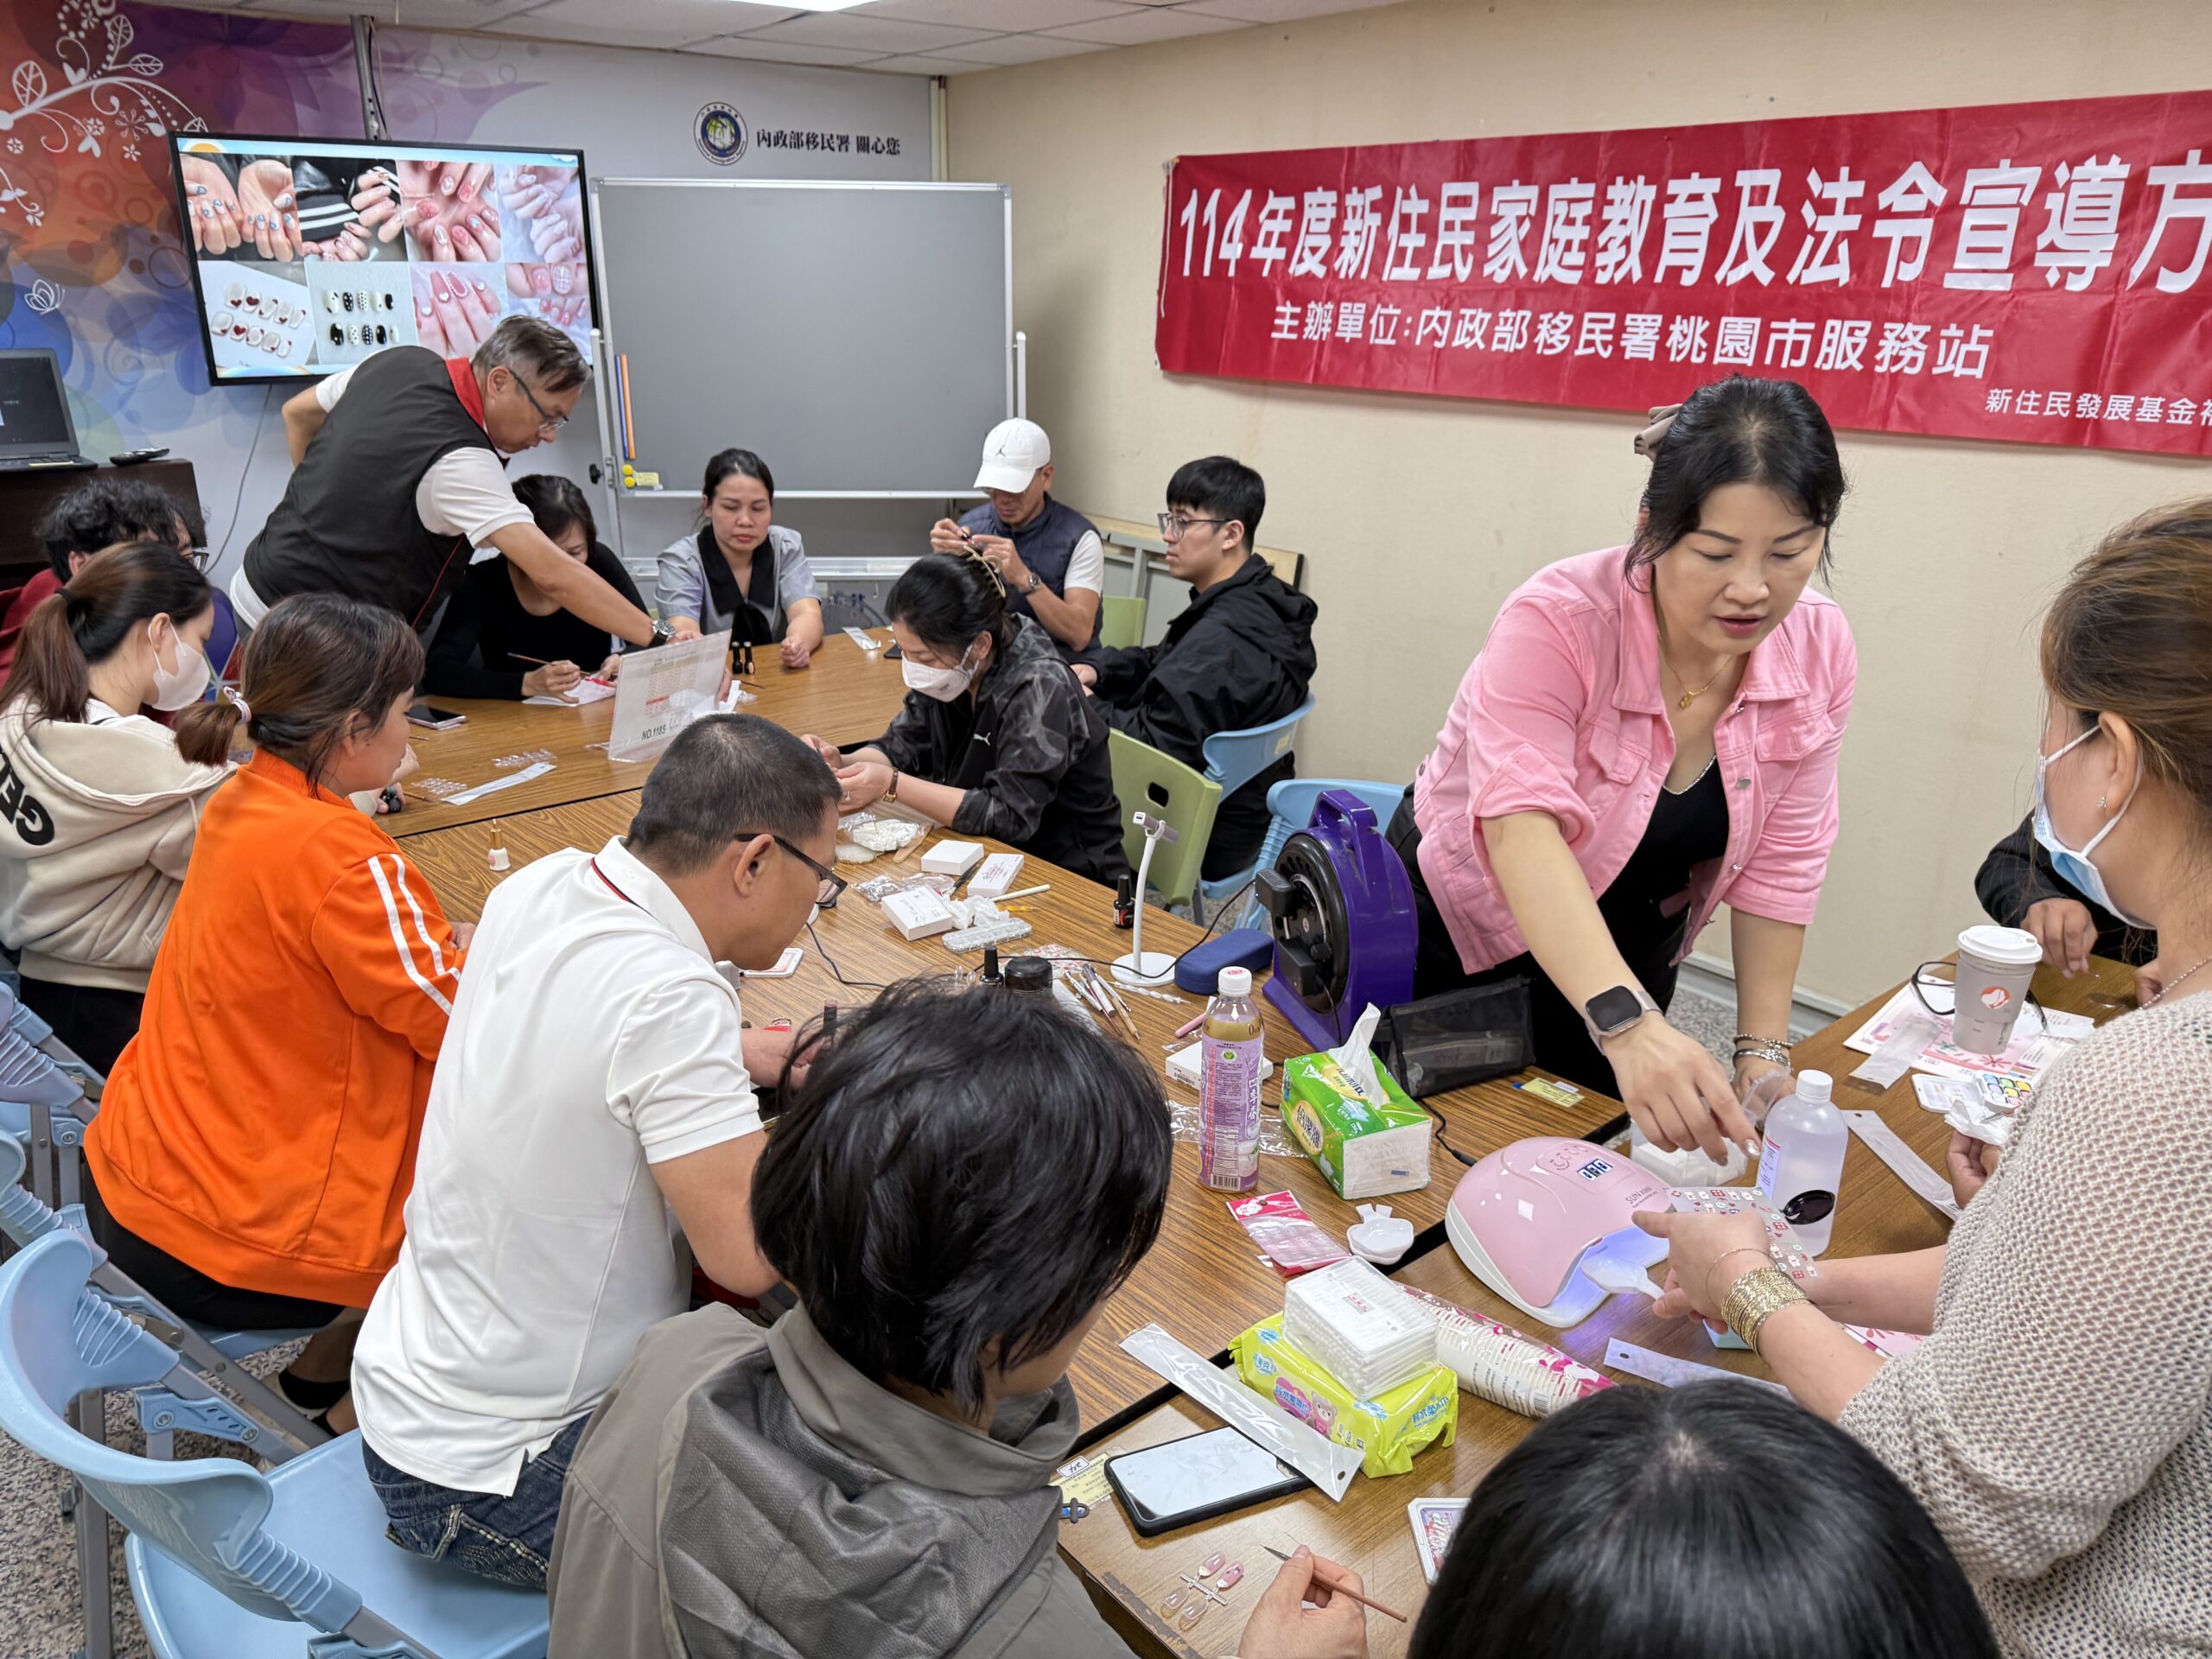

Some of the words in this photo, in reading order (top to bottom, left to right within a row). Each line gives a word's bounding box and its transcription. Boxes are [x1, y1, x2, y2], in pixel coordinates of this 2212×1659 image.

[1180, 149, 2212, 294] 114年度新住民家庭教育及法令宣導方
